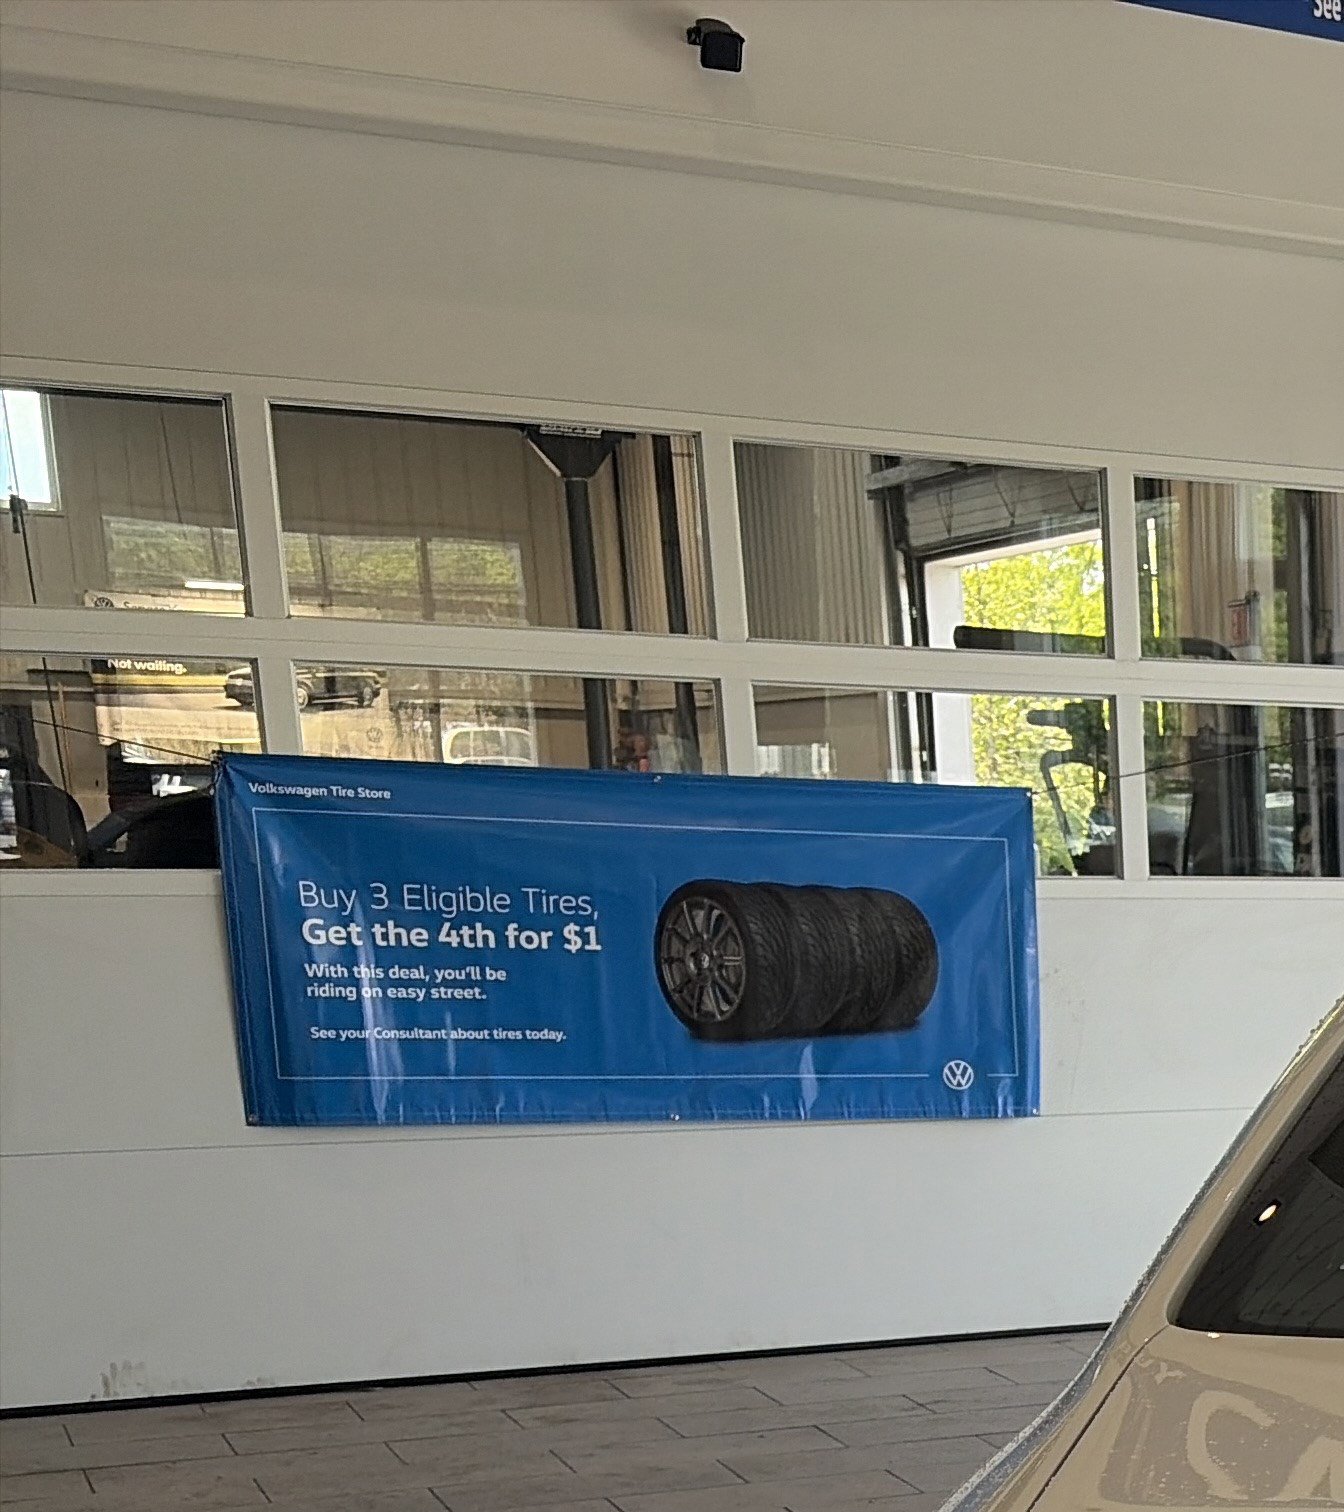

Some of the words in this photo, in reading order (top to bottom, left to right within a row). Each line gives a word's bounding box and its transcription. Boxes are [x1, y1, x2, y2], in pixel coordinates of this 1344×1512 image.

[1314, 0, 1342, 21] See
[107, 658, 132, 670] Not
[248, 782, 328, 798] Volkswagen
[329, 785, 355, 798] Tire
[357, 787, 391, 799] Store
[298, 880, 357, 916] Buy
[369, 883, 389, 910] 3
[402, 884, 511, 918] Eligible
[521, 887, 599, 920] Tires,
[301, 918, 363, 946] Get
[370, 920, 429, 948] the
[438, 921, 496, 949] 4th
[504, 922, 554, 950] for
[562, 922, 602, 953] $1
[304, 963, 348, 979] With
[352, 964, 385, 980] this
[388, 964, 430, 982] deal,
[485, 966, 507, 981] be
[306, 983, 357, 1001] riding
[361, 986, 383, 999] on
[387, 986, 427, 1002] easy
[430, 986, 487, 1000] street.
[310, 1027, 337, 1039] See
[338, 1030, 371, 1043] your
[373, 1027, 447, 1041] Consultant
[449, 1028, 490, 1041] about
[492, 1028, 522, 1041] tires
[524, 1029, 567, 1043] today.
